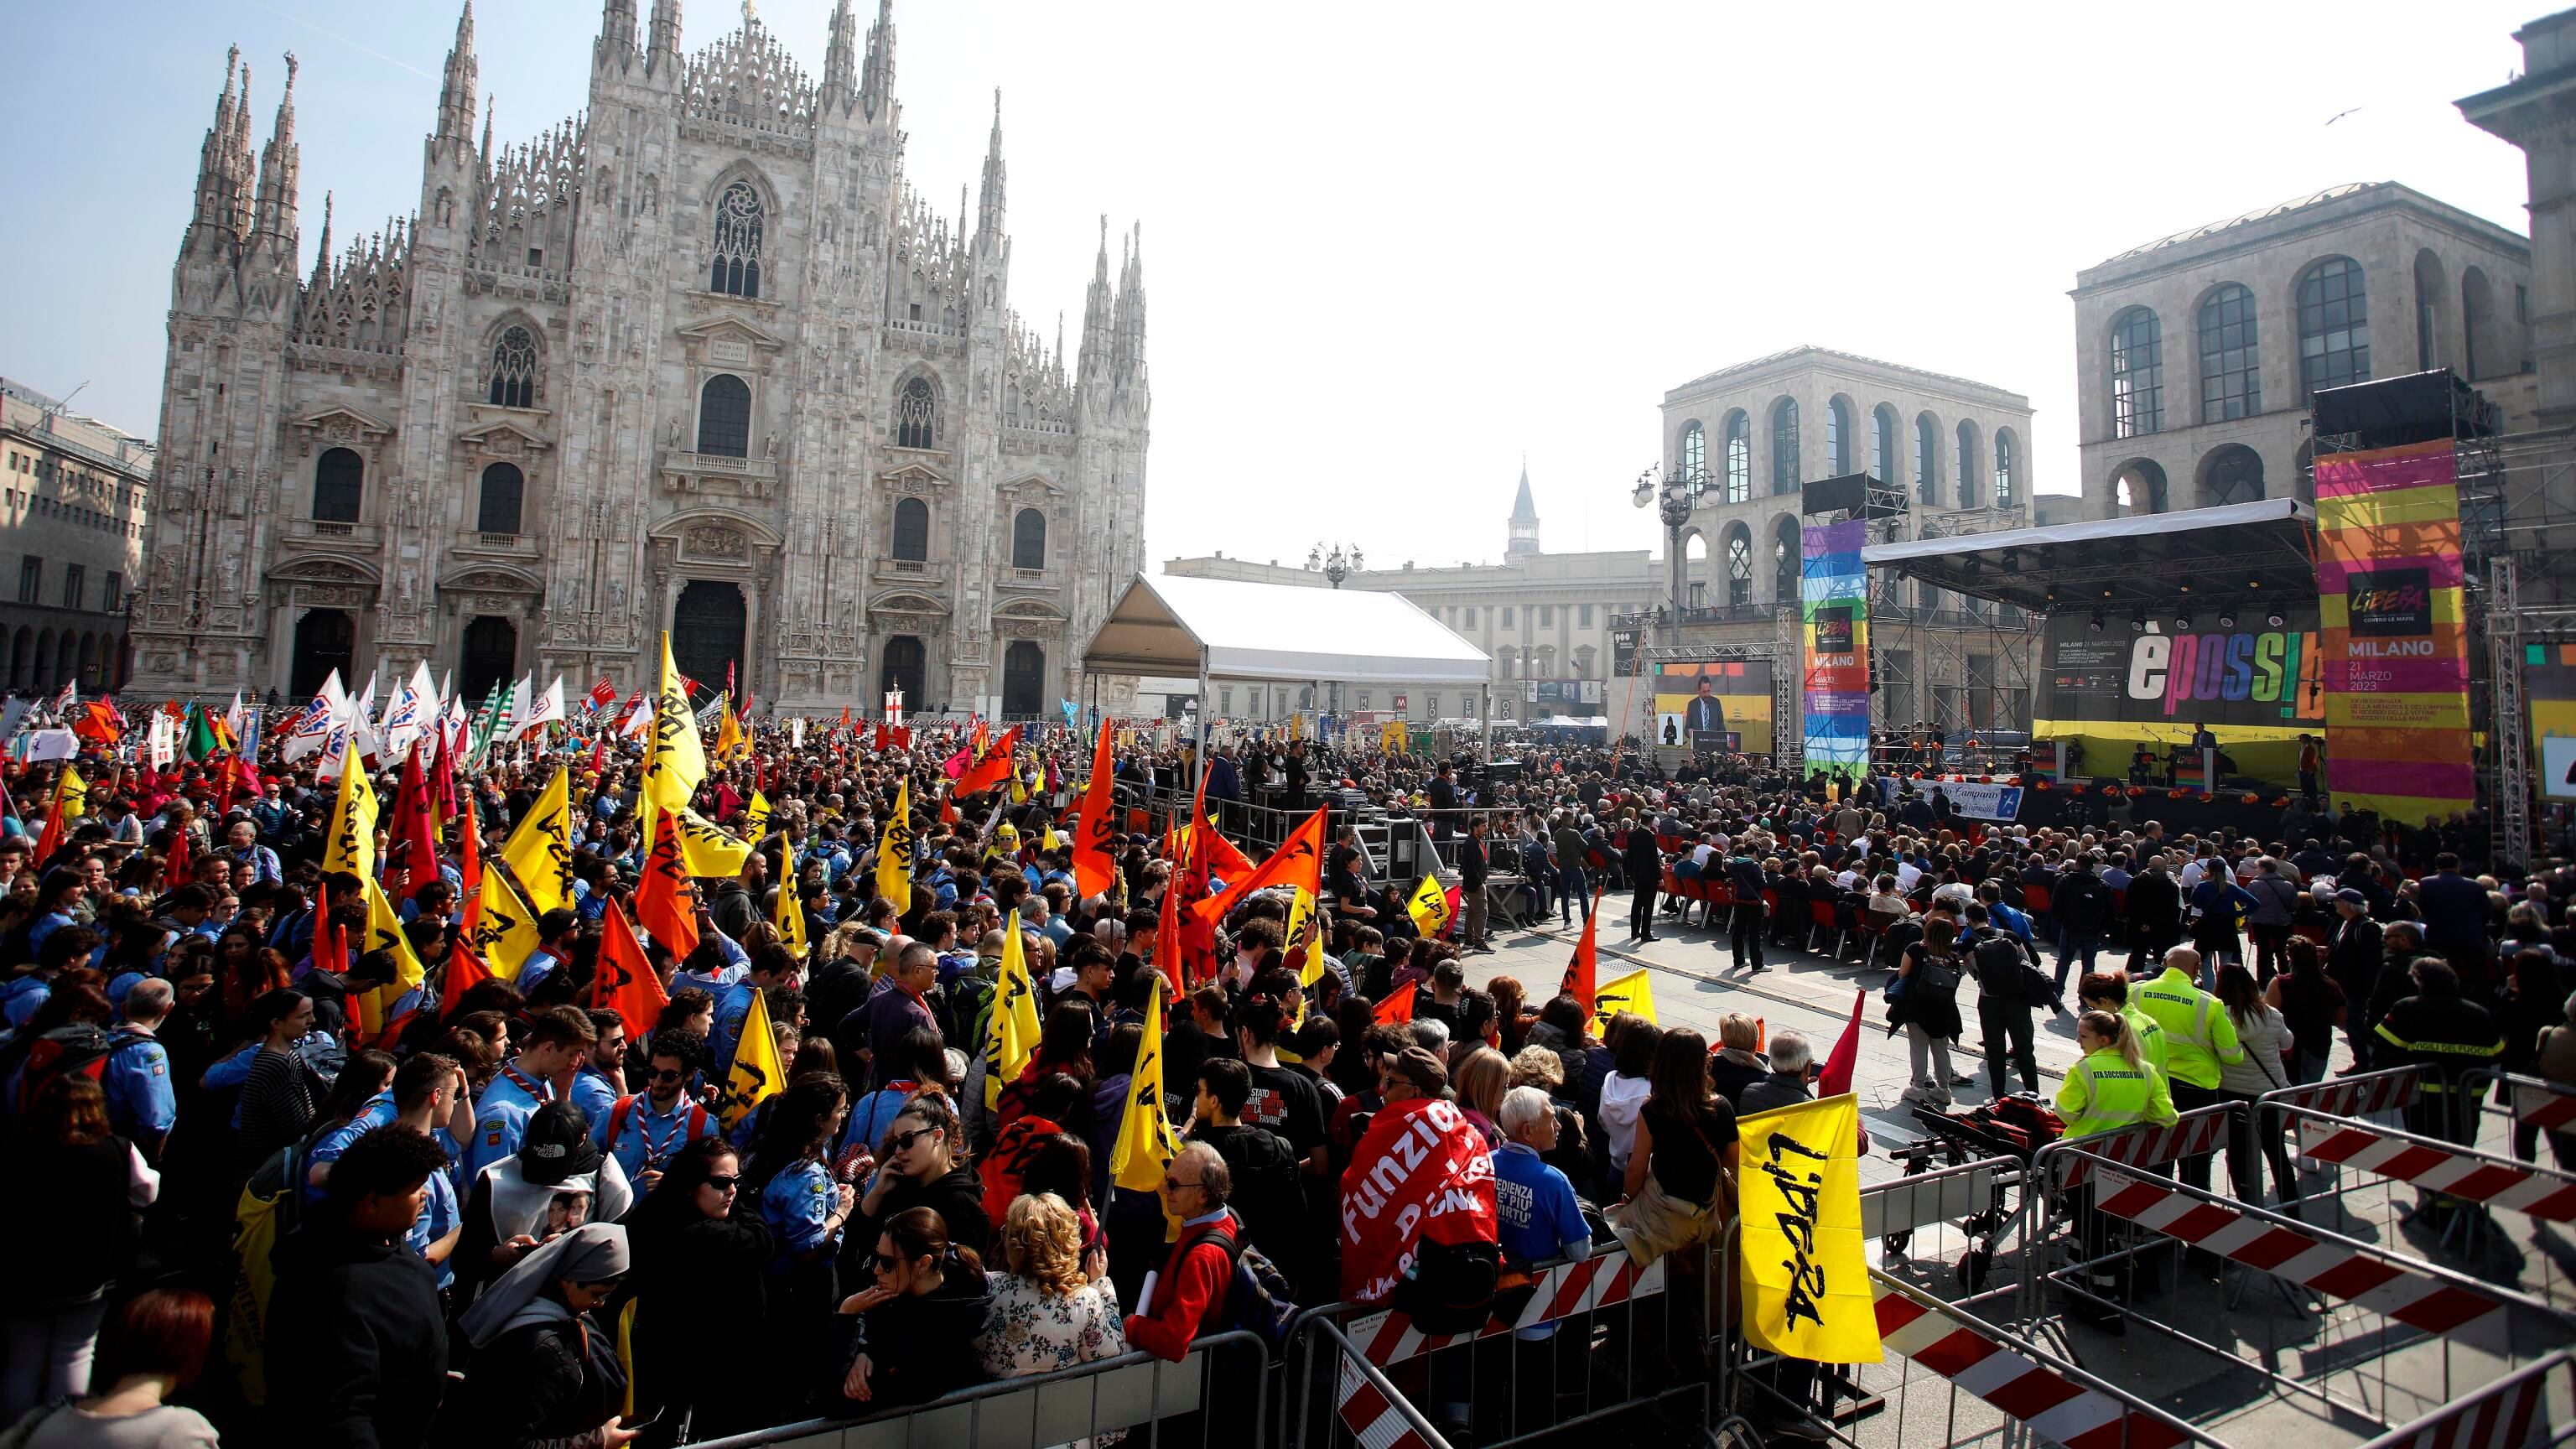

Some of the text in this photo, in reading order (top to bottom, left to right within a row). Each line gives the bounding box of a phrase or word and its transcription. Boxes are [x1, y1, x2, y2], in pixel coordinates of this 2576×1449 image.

[2348, 641, 2434, 657] MILANO
[1815, 656, 1854, 667] MILANO
[2350, 662, 2360, 671] 21
[2350, 671, 2392, 681] MARZO
[2350, 682, 2376, 691] 2023
[1955, 787, 1998, 799] Campano
[2153, 992, 2181, 1003] SOCCORSO
[2181, 997, 2194, 1006] ODV
[2414, 1041, 2438, 1051] VIGILI
[2441, 1044, 2456, 1052] DEL
[2093, 1071, 2104, 1079] ATA
[2105, 1070, 2133, 1079] SOCCORSO
[1250, 1088, 1270, 1098] STATO
[1244, 1096, 1261, 1106] OME
[1254, 1105, 1261, 1114] LA
[1259, 1114, 1282, 1126] FAVORE
